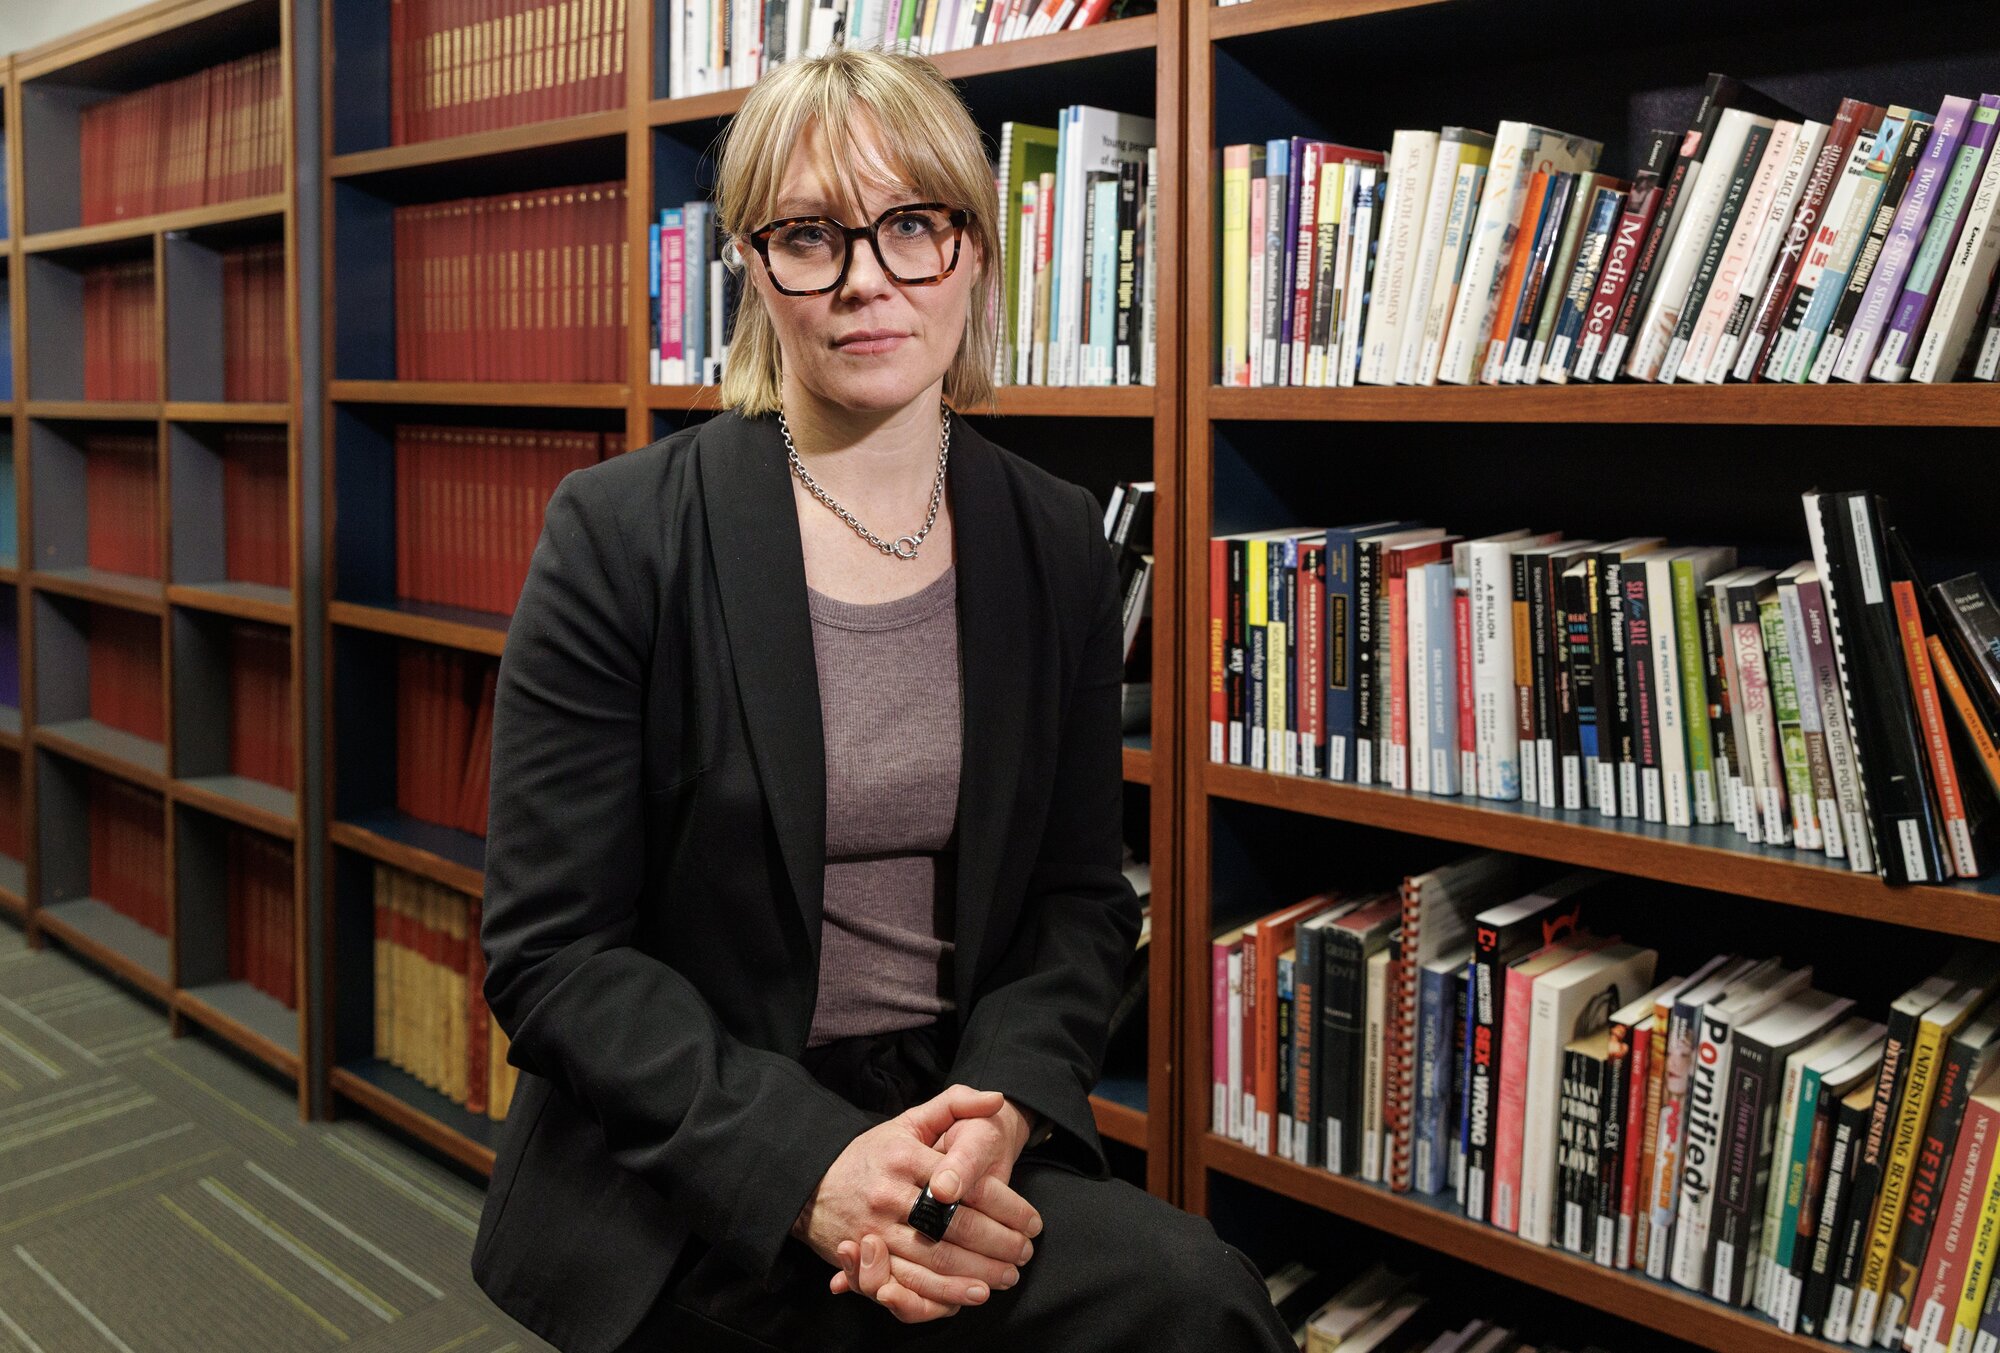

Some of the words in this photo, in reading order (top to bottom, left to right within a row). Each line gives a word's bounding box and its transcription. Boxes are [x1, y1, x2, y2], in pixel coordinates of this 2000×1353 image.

[1771, 128, 1789, 156] THE
[1929, 115, 1956, 160] McLaren
[1404, 146, 1421, 175] SEX,
[1440, 145, 1454, 175] WHY
[1808, 142, 1844, 207] america's
[1810, 141, 1833, 178] war
[1727, 174, 1745, 201] SEX
[1742, 162, 1776, 227] POLITICS
[1940, 145, 1977, 220] net.seXXX
[1981, 167, 2000, 190] ON
[1268, 183, 1280, 231] Permitted
[1298, 184, 1315, 226] SEXUAL
[1399, 176, 1416, 220] DEATH
[1768, 205, 1785, 224] SEX
[1849, 182, 1879, 231] Crossing
[1973, 188, 1992, 215] SEX
[1395, 223, 1410, 248] AND
[1655, 209, 1669, 229] AND
[1777, 203, 1818, 263] sex
[1871, 202, 1897, 237] URBAN
[1878, 164, 1937, 285] TWENTIETH-CENTURY
[1321, 223, 1335, 272] PUBLIC
[1598, 216, 1644, 300] Media
[1638, 225, 1664, 273] ROMANCE
[1697, 215, 1730, 282] PLEASURE
[1734, 231, 1748, 248] OF
[1835, 230, 1859, 268] Sexual
[1958, 225, 1982, 268] Esquire
[1120, 261, 1135, 282] That
[1266, 249, 1278, 300] Prohibited
[1295, 230, 1312, 290] ATTITUDES
[1848, 234, 1884, 295] ABORIGINALS
[1383, 249, 1406, 327] PUNISHMENT
[1630, 280, 1642, 294] THE
[1706, 251, 1744, 320] LUST
[1265, 300, 1276, 335] Desires
[1621, 292, 1638, 319] MASS
[1360, 555, 1369, 578] SEX
[1473, 556, 1483, 601] WICKED
[1514, 559, 1525, 598] STAPLES
[1603, 563, 1622, 596] Paying
[1486, 583, 1494, 591] A
[1609, 595, 1623, 611] for
[1625, 579, 1644, 600] SEX
[1675, 575, 1691, 617] Whores
[1359, 581, 1369, 642] SURVEYED
[1486, 594, 1495, 640] BILLION
[1533, 603, 1545, 628] DOWN
[1626, 598, 1646, 619] for
[1805, 606, 1825, 646] Jeffreys
[1211, 618, 1222, 672] REGULATING
[1475, 605, 1485, 665] THOUGHTS
[1535, 628, 1546, 655] UNDER
[1609, 610, 1626, 653] Pleasure
[1629, 618, 1648, 647] SALE
[1657, 634, 1668, 651] THE
[1682, 619, 1695, 640] and
[1736, 625, 1757, 651] SEX
[1250, 629, 1265, 680] sexology
[1268, 626, 1283, 674] sexology
[1431, 647, 1443, 686] SELLING
[1461, 648, 1471, 662] and
[1614, 656, 1625, 674] Men
[1683, 641, 1698, 673] Other
[1211, 675, 1222, 693] SEX
[1272, 677, 1283, 688] in
[1615, 674, 1626, 690] who
[1658, 653, 1671, 693] POLITICS
[1740, 651, 1766, 711] CHANGES
[1778, 660, 1795, 686] MADE
[1795, 669, 1810, 682] In
[1359, 691, 1369, 726] Stanley
[1434, 686, 1444, 703] SEX
[1463, 687, 1473, 709] health
[1519, 685, 1531, 731] SEXUALITY
[1615, 691, 1628, 707] Buy
[1638, 691, 1651, 726] RONALD
[1663, 695, 1673, 707] OF
[1686, 674, 1704, 729] Feminists
[1783, 689, 1799, 711] HIM
[1799, 689, 1819, 728] Queer
[1918, 686, 1941, 734] MASCULINITY
[1434, 703, 1446, 735] SHORT
[1618, 706, 1629, 722] Sex
[1664, 710, 1675, 727] SEX
[1754, 712, 1764, 725] The
[1817, 663, 1841, 728] UNPACKING
[1829, 727, 1848, 765] QUEER
[1961, 704, 1997, 760] CONUNDRUM
[1641, 726, 1654, 765] WEITZER
[1755, 725, 1768, 751] Politics
[1808, 732, 1828, 763] Time
[1930, 733, 1944, 750] AND
[1932, 748, 1952, 786] SEXUALITY
[1943, 794, 1958, 814] HIGH
[1294, 982, 1311, 1049] HARMFUL
[1472, 1024, 1491, 1067] SEX
[1420, 1060, 1435, 1097] KING
[1874, 1037, 1902, 1101] DEVIANT
[1937, 1060, 1961, 1110] Steele
[1295, 1065, 1310, 1122] MINORS
[1469, 1074, 1489, 1146] WRONG
[1681, 1015, 1729, 1193] Pornified
[1894, 1043, 1934, 1158] UNDERSTANDING
[1602, 1120, 1620, 1152] SEX
[1834, 1122, 1851, 1142] THE
[1861, 1099, 1889, 1166] DESIRES
[1970, 1113, 1991, 1146] NEW
[1828, 1139, 1849, 1173] VAGINA
[1957, 1141, 1984, 1196] GROWTH
[1819, 1169, 1842, 1226] MONOLOGUES
[1876, 1161, 1906, 1236] BESTIALITY
[1905, 1135, 1944, 1226] FETISH
[1948, 1192, 1970, 1229] FROM
[1872, 1238, 1887, 1249] &
[1942, 1225, 1961, 1254] OLD
[1975, 1215, 1994, 1256] POLICY
[1963, 1257, 1984, 1302] MAKING
